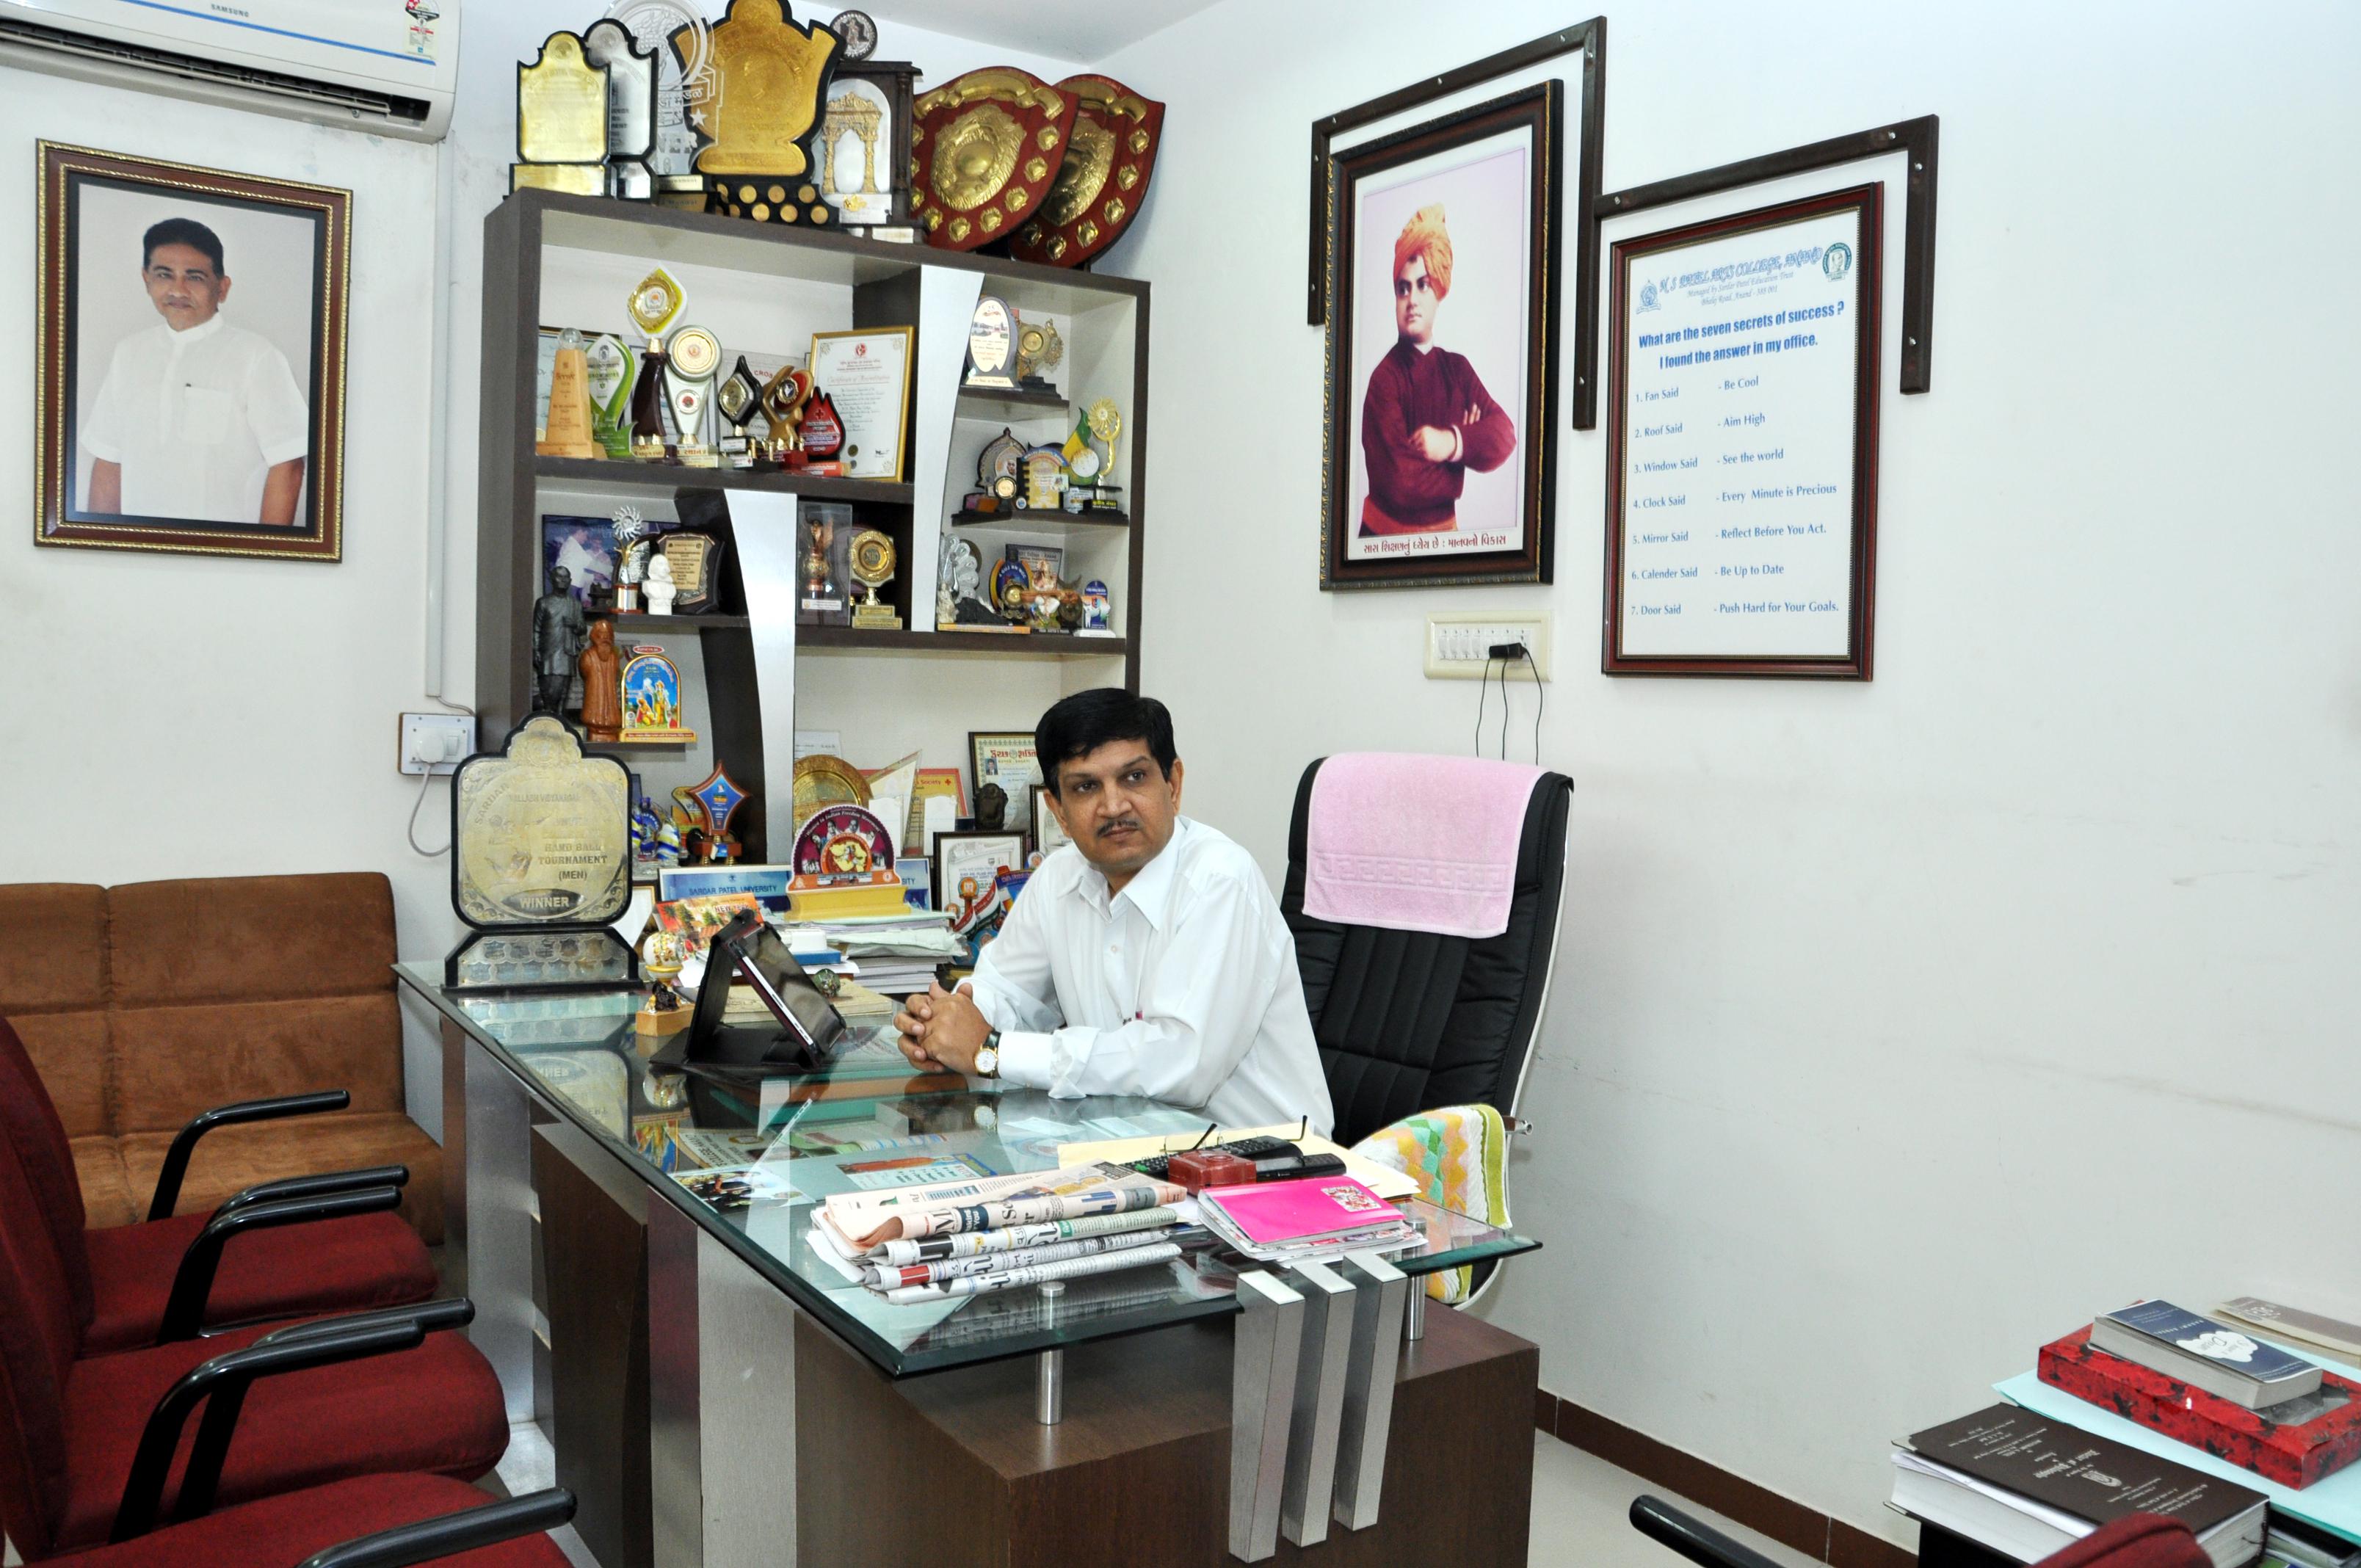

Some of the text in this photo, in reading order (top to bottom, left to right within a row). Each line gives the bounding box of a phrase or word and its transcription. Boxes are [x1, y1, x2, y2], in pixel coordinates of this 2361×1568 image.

[211, 3, 250, 18] SAMSUNG
[1639, 300, 1844, 349] What are the seven secrets of success ?
[1665, 351, 1693, 368] found
[1695, 348, 1711, 363] the
[1713, 342, 1751, 360] answer
[1753, 341, 1763, 355] in
[1765, 339, 1782, 355] my
[1783, 333, 1818, 351] office.
[753, 369, 774, 379] CROS
[1635, 393, 1643, 403] 1.
[1645, 391, 1660, 401] Fan
[1661, 388, 1679, 399] Said
[1724, 380, 1736, 391] Be
[1738, 376, 1759, 388] Cool
[1634, 429, 1642, 439] 2.
[1644, 426, 1664, 438] Roof
[1665, 423, 1683, 435] Said
[1724, 416, 1741, 427] Aim
[1744, 413, 1766, 426] High
[1634, 463, 1642, 474] 3.
[1644, 461, 1678, 473] Window
[1680, 457, 1698, 469] Said
[1722, 454, 1738, 465] See
[1741, 452, 1755, 463] the
[1756, 449, 1784, 462] world
[1633, 499, 1642, 509] 4.
[1643, 496, 1666, 508] Clock
[1668, 495, 1686, 506] Said
[1722, 490, 1746, 504] Every
[1752, 487, 1783, 500] Minute
[1785, 486, 1794, 497] is
[1796, 484, 1837, 496] Precious
[1633, 535, 1640, 545] 5.
[1642, 532, 1669, 544] Mirror
[1671, 531, 1689, 542] Said
[1721, 528, 1752, 540] Reflect
[1754, 526, 1784, 537] Before
[1787, 524, 1805, 535] You
[1807, 523, 1827, 534] Act.
[1631, 570, 1639, 580] 6.
[1642, 568, 1678, 579] Calender
[1680, 567, 1698, 578] Said
[1720, 566, 1732, 576] Be
[1734, 565, 1748, 578] Up
[1750, 566, 1760, 576] to
[1762, 564, 1785, 575] Date
[1631, 606, 1639, 615] 7.
[1641, 605, 1662, 615] Door
[1664, 603, 1682, 615] Said
[1719, 601, 1741, 614] Push
[1742, 601, 1766, 614] Hard
[1768, 601, 1782, 613] for
[1785, 600, 1807, 612] Your
[1808, 600, 1839, 612] Goals.
[825, 812, 841, 820] Indian
[841, 810, 861, 818] Freedom
[537, 855, 608, 865] TOURNAMENT
[558, 870, 587, 882] (MEN)
[689, 883, 778, 896] SARDAR PATEL UNIVERSITY
[519, 896, 570, 908] WINNER
[714, 906, 732, 914] NEW
